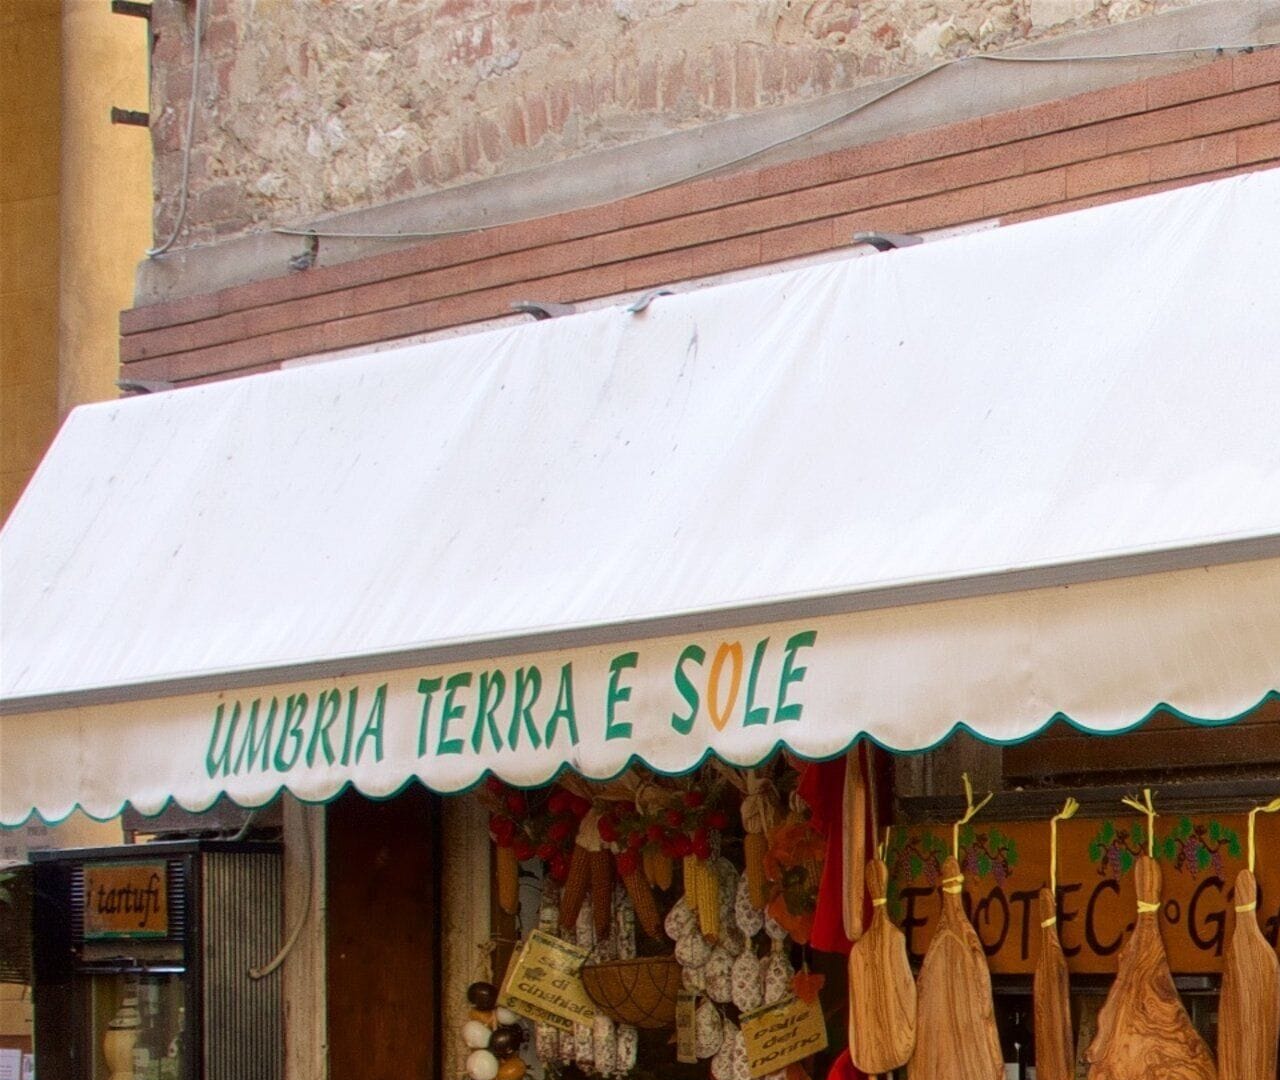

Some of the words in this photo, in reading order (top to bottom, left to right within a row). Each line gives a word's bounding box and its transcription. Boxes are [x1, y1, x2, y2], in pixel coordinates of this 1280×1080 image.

[204, 682, 389, 780] UMBRIA
[416, 661, 580, 758] TERRA
[604, 650, 640, 740] E
[670, 630, 819, 736] SOLE
[97, 873, 161, 928] tartufi
[899, 878, 1137, 961] EOTEC
[517, 982, 595, 1019] cinghiale
[551, 979, 571, 992] di
[751, 1032, 821, 1069] nonno
[761, 1026, 799, 1050] del
